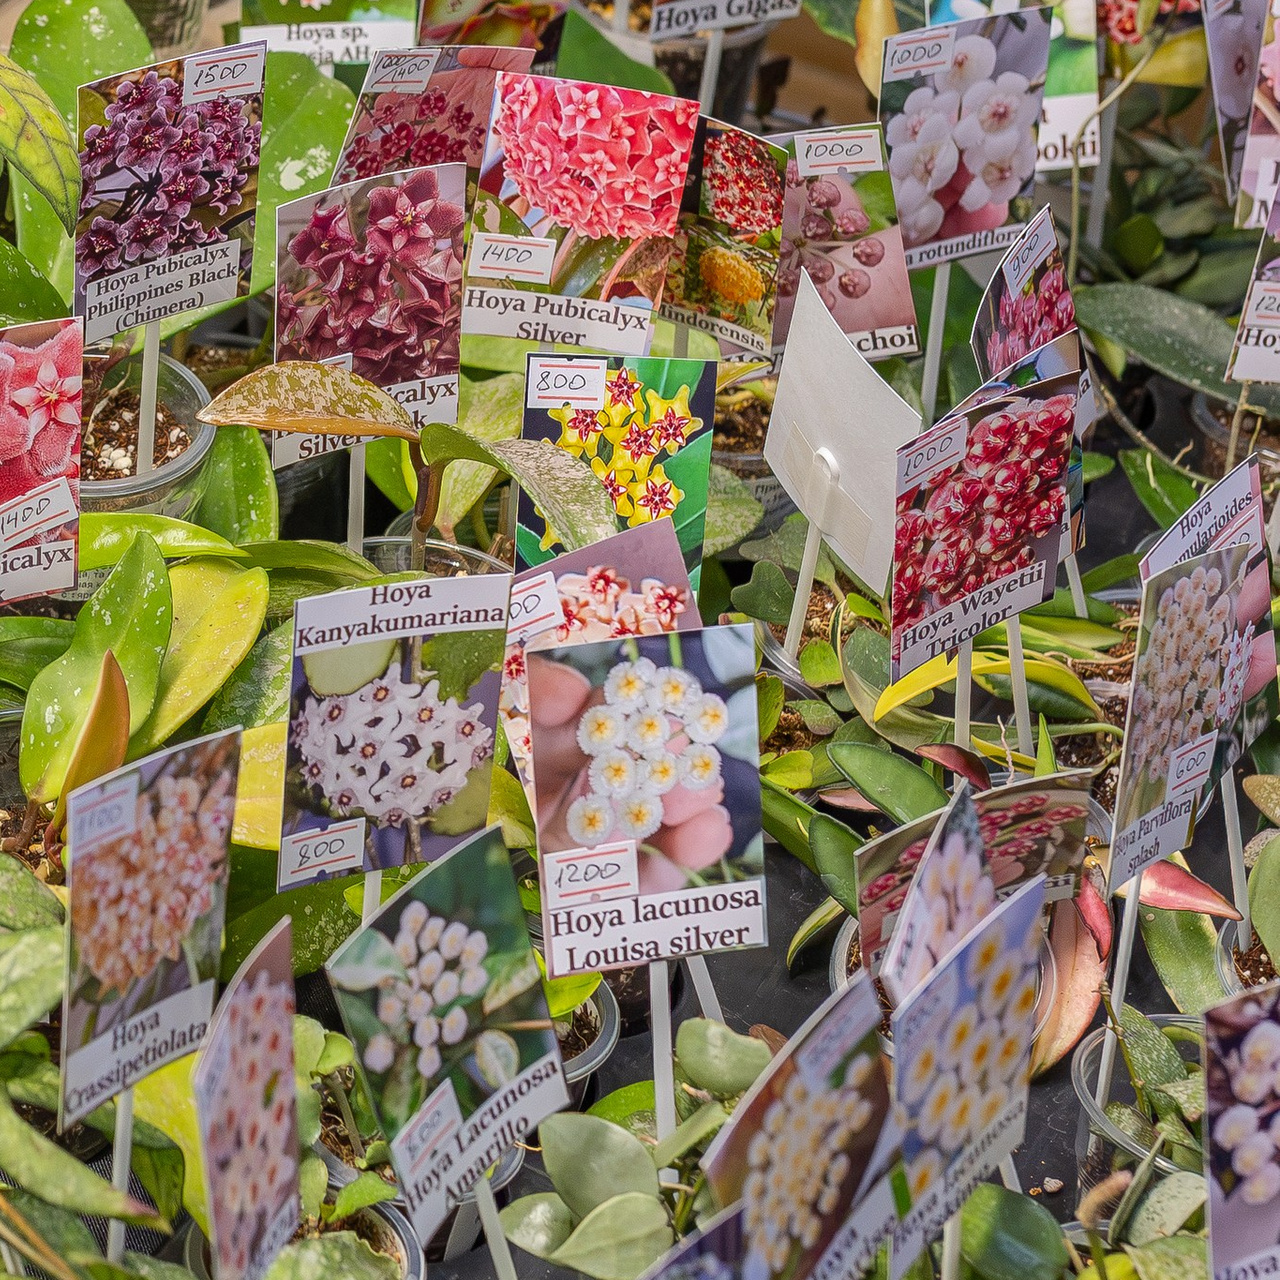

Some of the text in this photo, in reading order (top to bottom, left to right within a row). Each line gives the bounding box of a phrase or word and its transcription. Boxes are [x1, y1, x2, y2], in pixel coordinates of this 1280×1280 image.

[287, 24, 368, 42] Hoya sp.
[655, 3, 717, 33] Hoya
[193, 60, 247, 84] 1500
[892, 41, 944, 66] 1000
[805, 139, 864, 160] 1000
[482, 243, 533, 265] 1400
[1012, 234, 1041, 277] 900
[95, 246, 230, 301] Hoya Pubicalyx
[87, 264, 237, 323] Philippines Black
[115, 291, 205, 331] (Chimera)
[466, 290, 646, 331] Hoya Pubicalyx
[516, 320, 586, 347] Silver
[851, 326, 916, 352] choi
[387, 381, 457, 405] icalyx
[536, 371, 586, 392] 800
[903, 434, 955, 476] 1000
[0, 498, 50, 534] 1400
[1179, 501, 1213, 539] Hoya
[368, 581, 432, 609] Hoya
[509, 592, 542, 620] 00
[901, 561, 1044, 655] Hoya Wayetii
[297, 600, 504, 647] Kanyakumariana
[925, 602, 1013, 662] Tricolor
[1176, 751, 1206, 779] 600
[1138, 799, 1191, 840] Parviflora
[298, 837, 345, 869] 800
[1128, 837, 1160, 876] splash
[554, 860, 622, 889] 1200
[551, 886, 760, 937] Hoya lacunosa
[565, 926, 749, 971] Louisa silver
[111, 1010, 160, 1052] Hoya
[405, 1060, 558, 1212] Hoya Lacunosa
[445, 1117, 529, 1201] Amarillo
